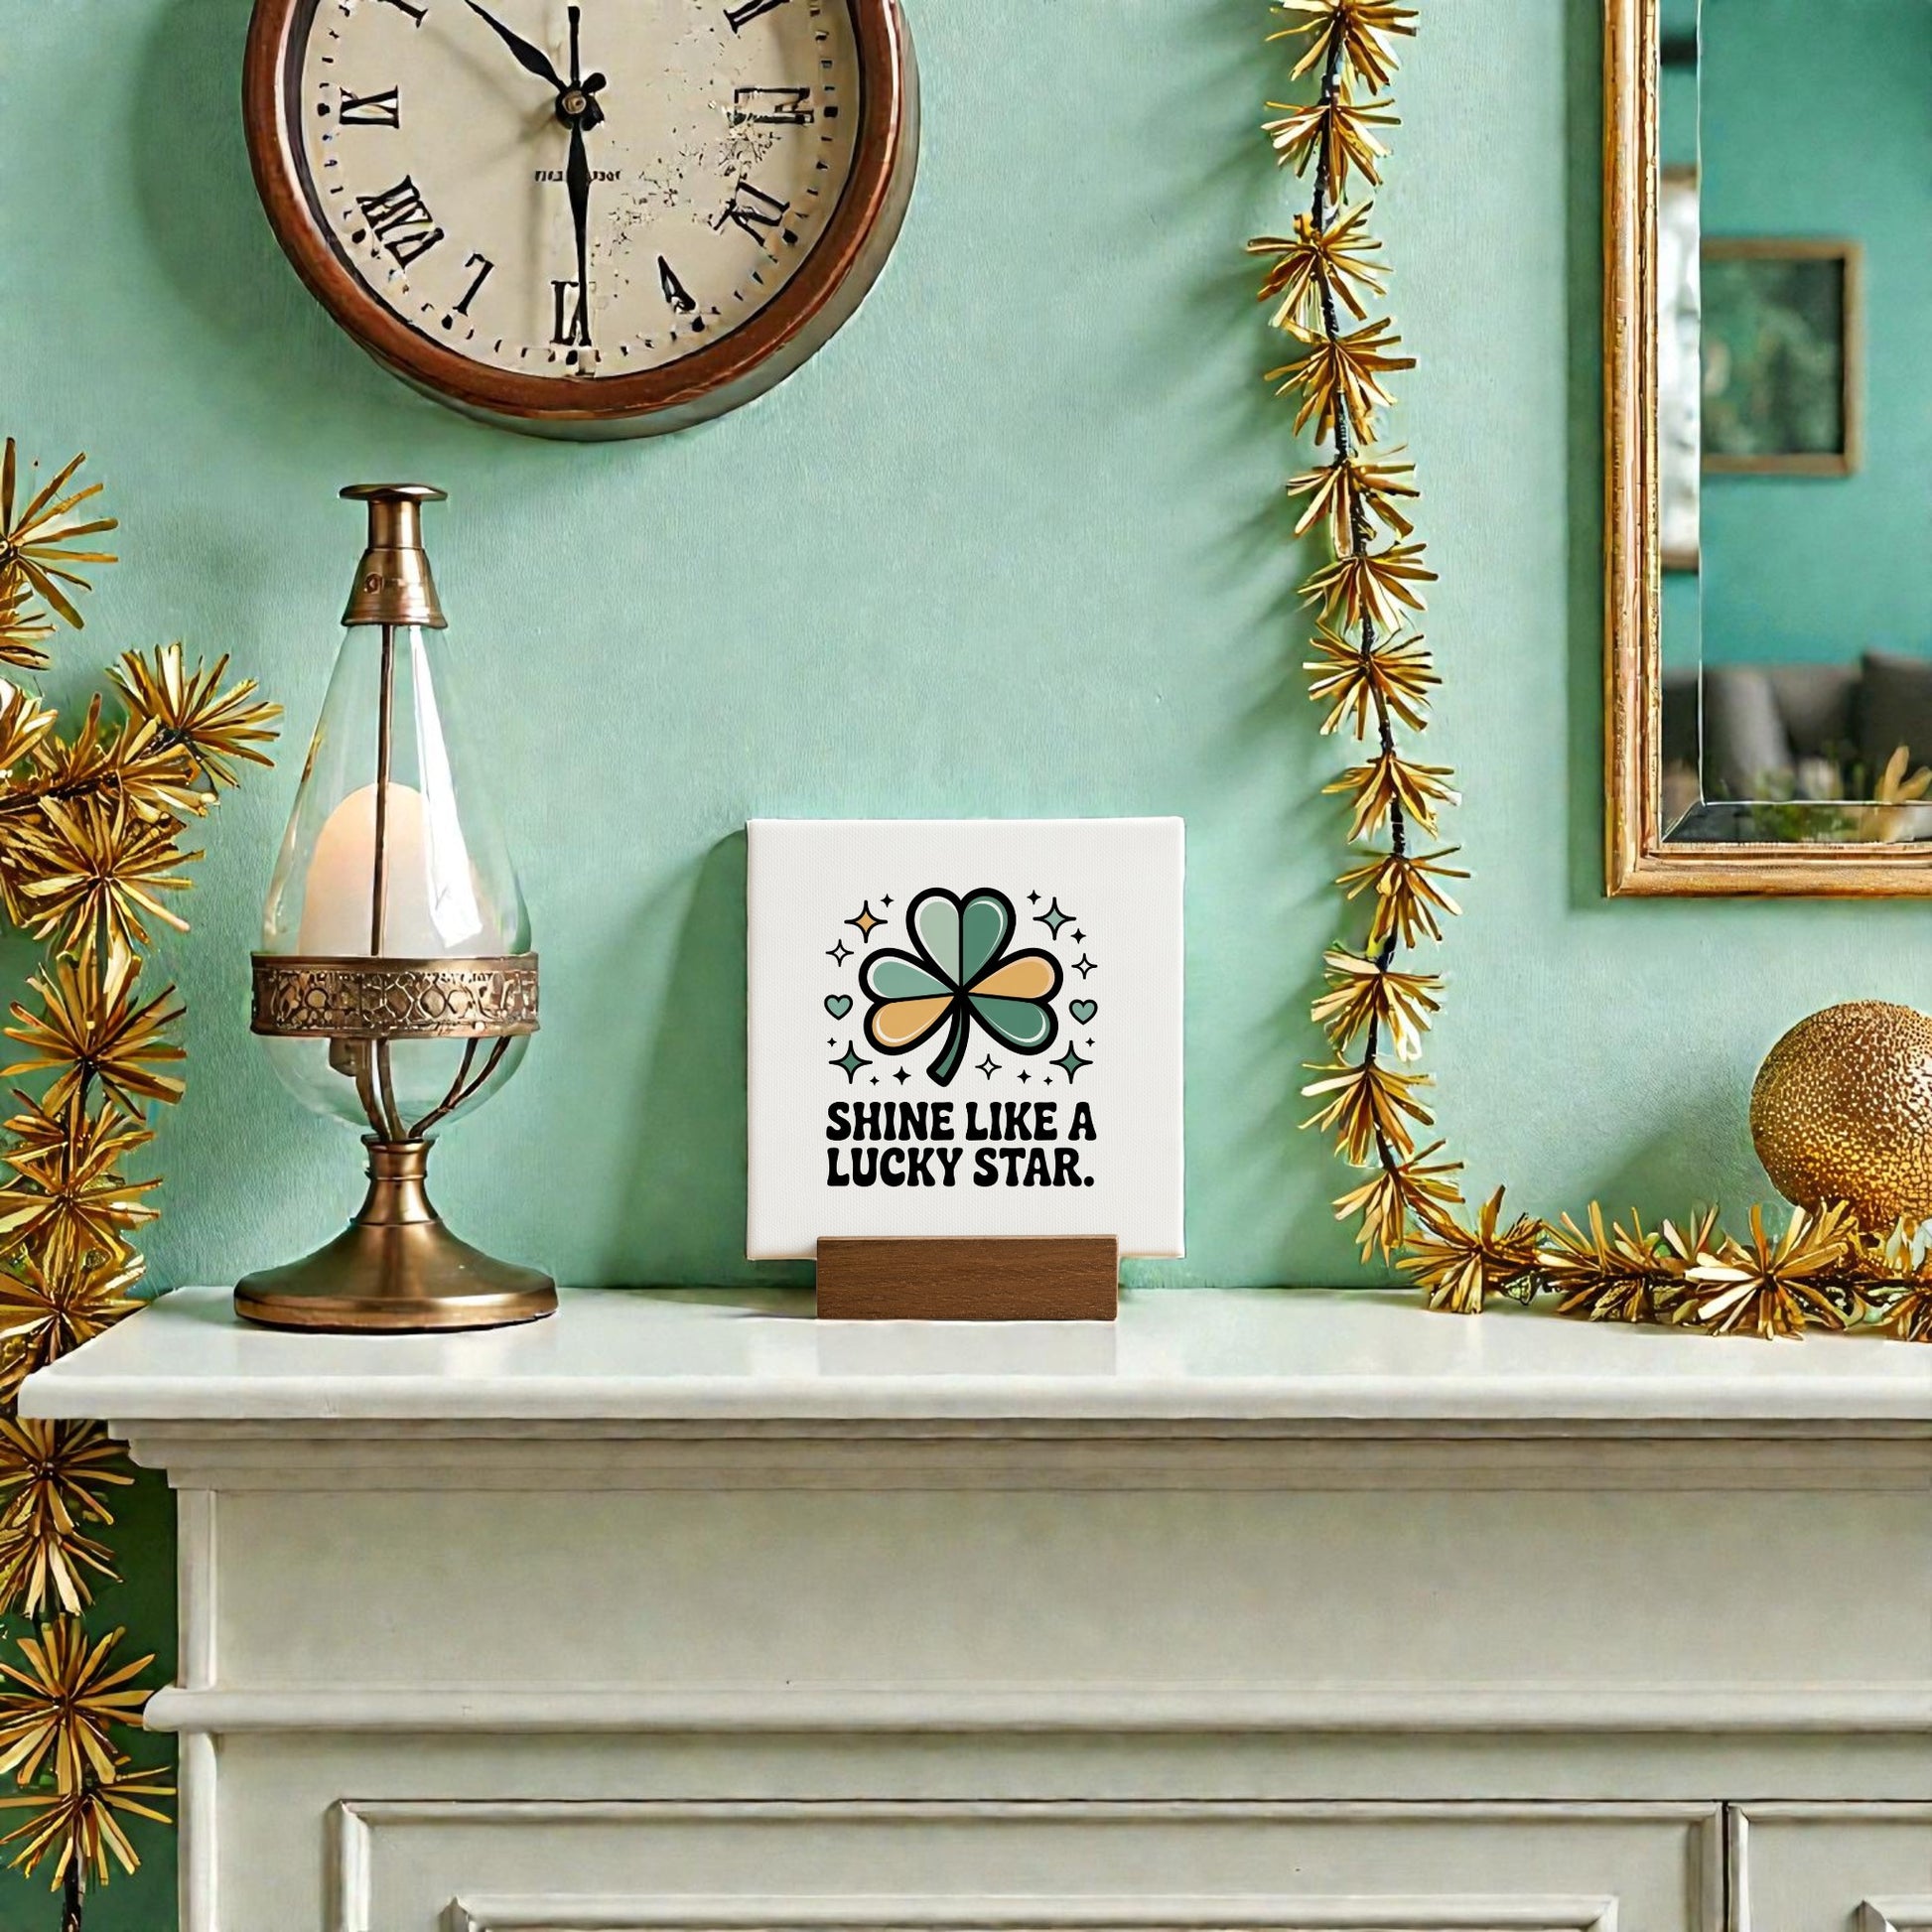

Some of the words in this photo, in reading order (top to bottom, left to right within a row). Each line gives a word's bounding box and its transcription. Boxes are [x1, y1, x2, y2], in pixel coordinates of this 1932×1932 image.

[825, 1101, 954, 1142] SHINE
[965, 1101, 1057, 1142] LIKE
[1067, 1101, 1097, 1142] A
[826, 1147, 963, 1187] LUCKY
[973, 1147, 1095, 1187] STAR.
